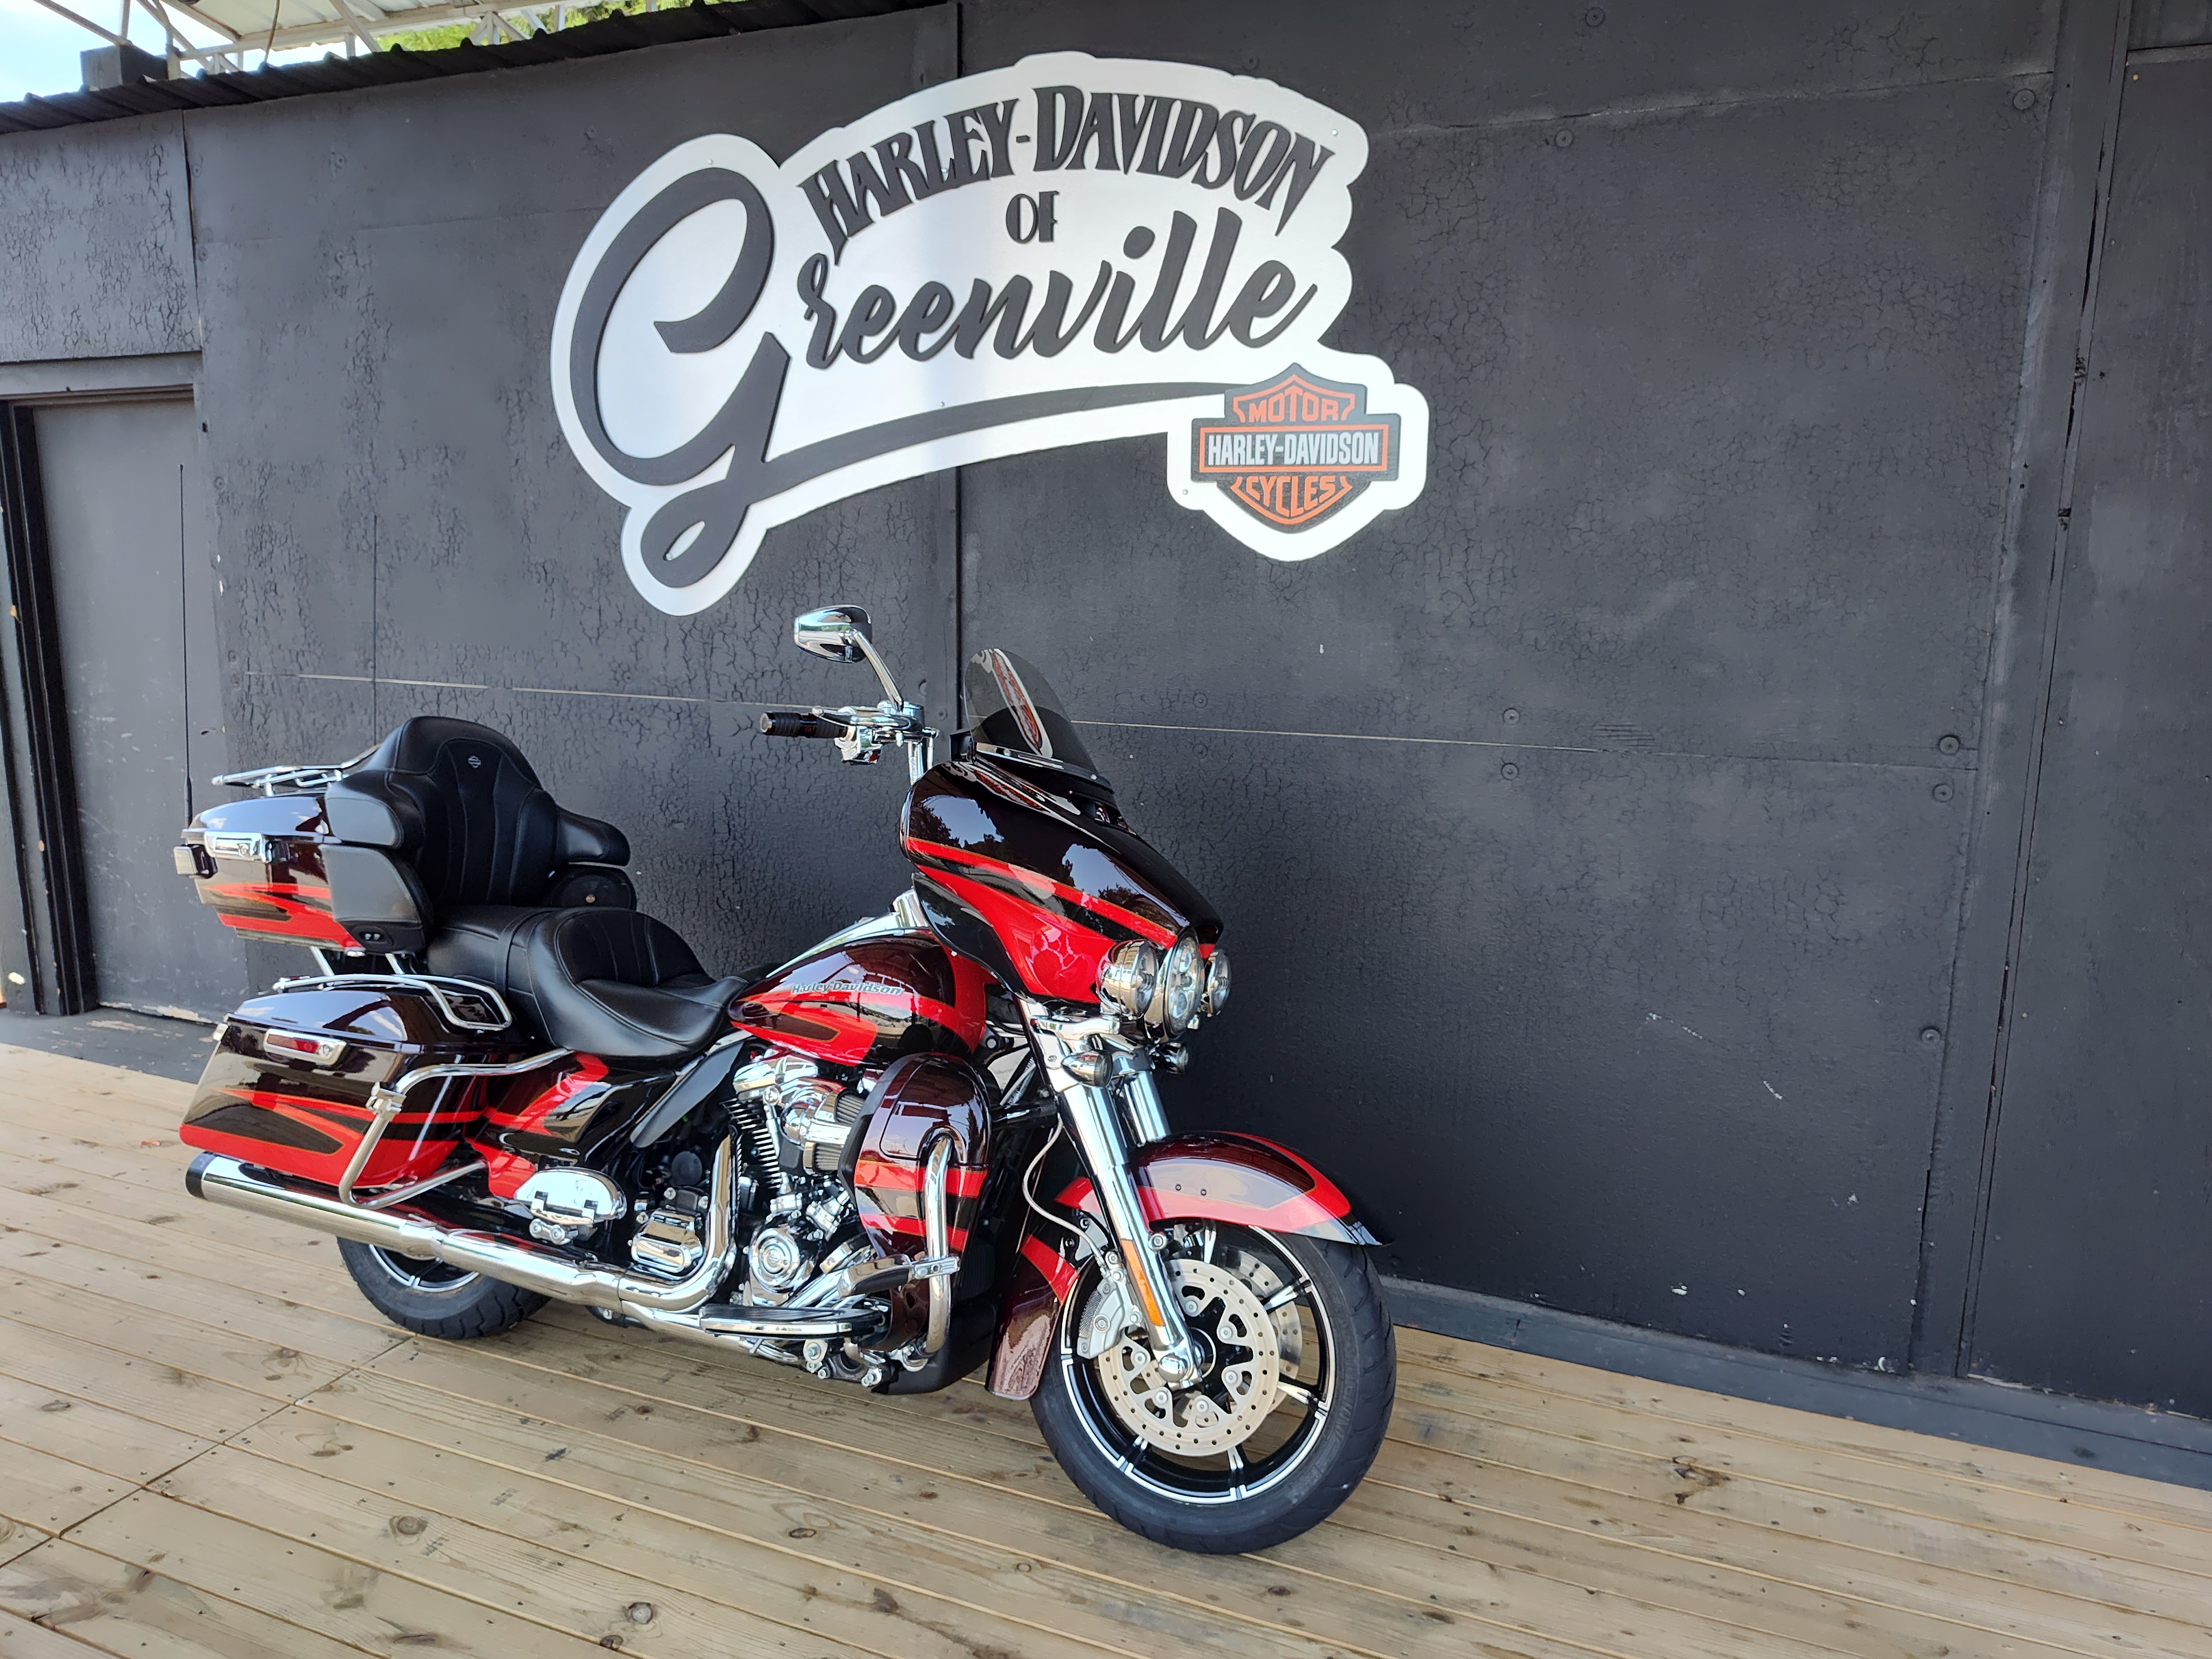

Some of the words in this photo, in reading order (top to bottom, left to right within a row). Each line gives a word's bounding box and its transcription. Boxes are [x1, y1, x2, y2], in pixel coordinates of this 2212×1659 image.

[800, 85, 1334, 266] HARLEY-DAVIDSON
[1005, 190, 1060, 244] OF
[569, 167, 1318, 589] Greenville
[1249, 385, 1339, 423] MOTOR
[1208, 432, 1379, 466] HARLEY-DAVIDSON
[1246, 475, 1336, 517] CYCLES
